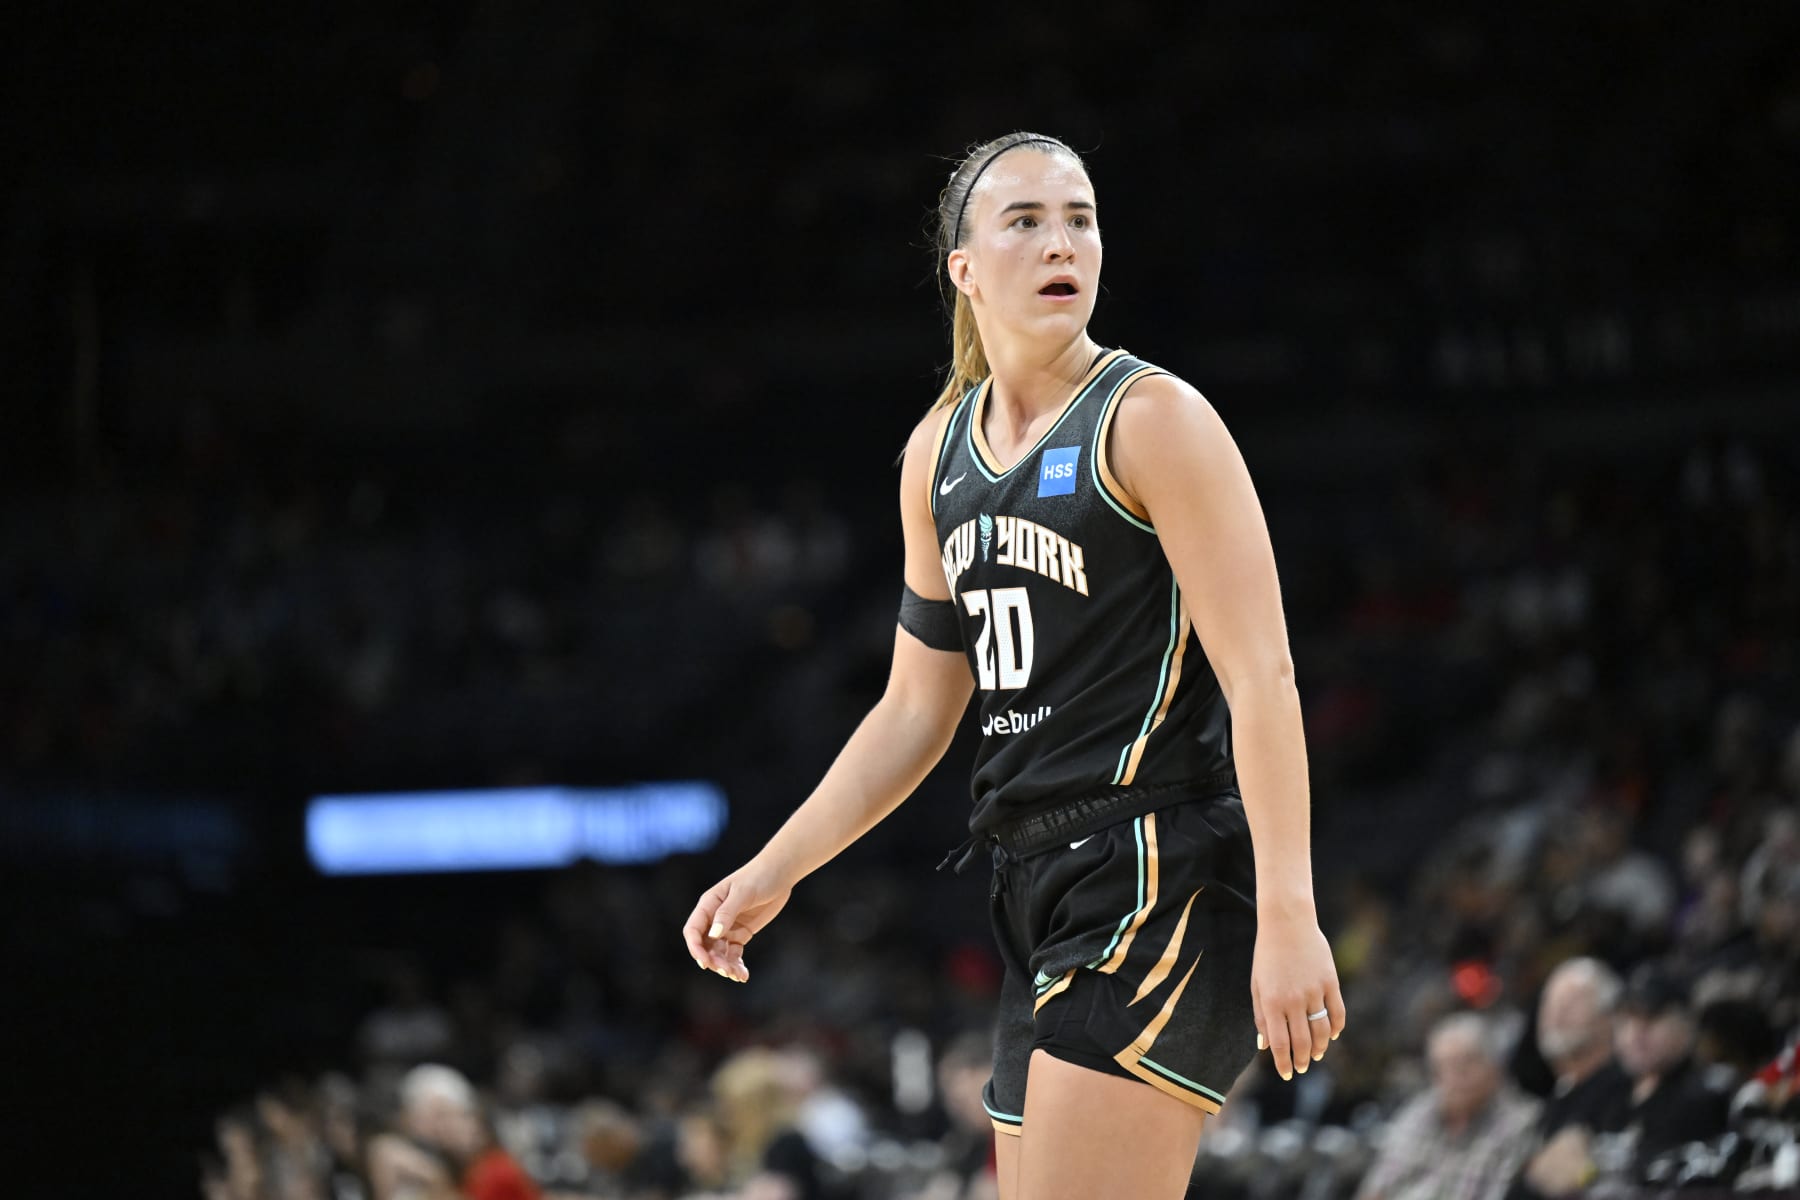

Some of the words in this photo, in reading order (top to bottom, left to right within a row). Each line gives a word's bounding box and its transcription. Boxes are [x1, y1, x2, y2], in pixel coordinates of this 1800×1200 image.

[1044, 462, 1073, 480] HSS
[995, 515, 1089, 597] YORK
[960, 587, 1034, 690] 20
